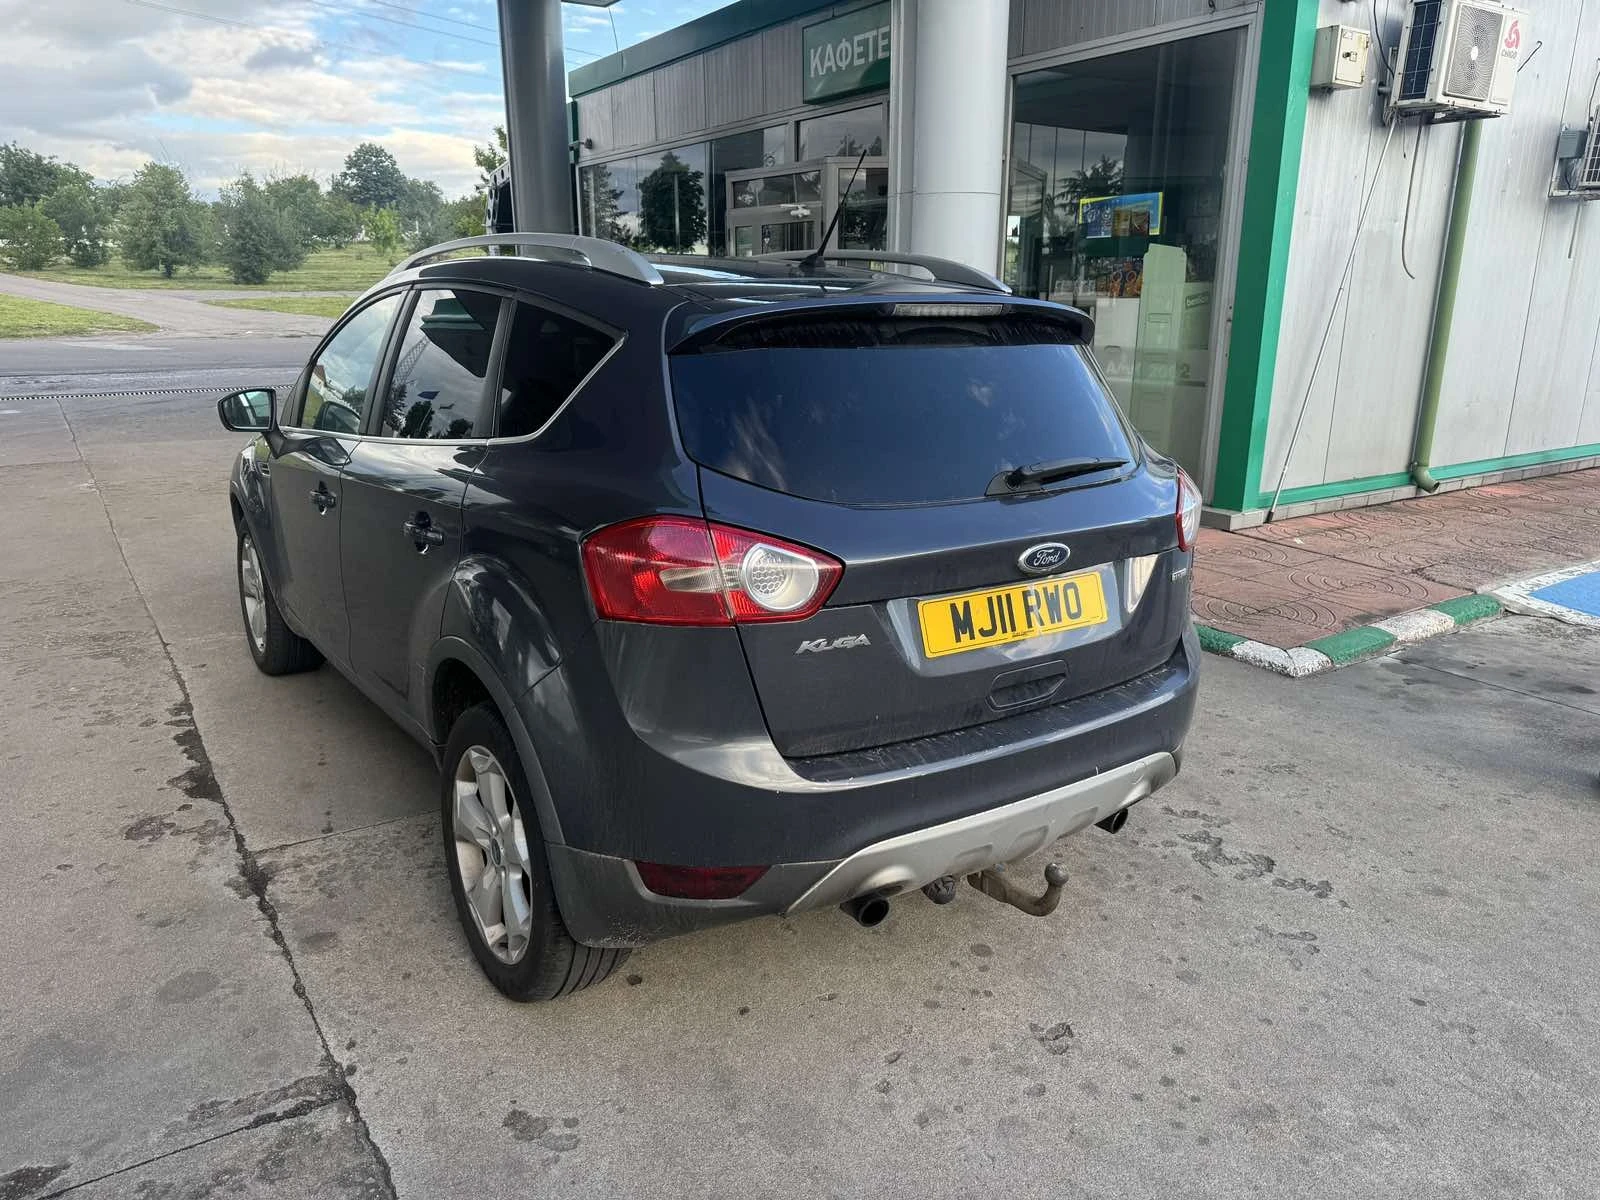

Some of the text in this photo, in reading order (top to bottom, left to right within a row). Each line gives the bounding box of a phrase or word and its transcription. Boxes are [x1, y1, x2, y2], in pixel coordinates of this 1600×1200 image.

[1033, 548, 1061, 566] Ford
[950, 581, 1083, 643] MJ11 RWO
[795, 633, 872, 655] KUGA
